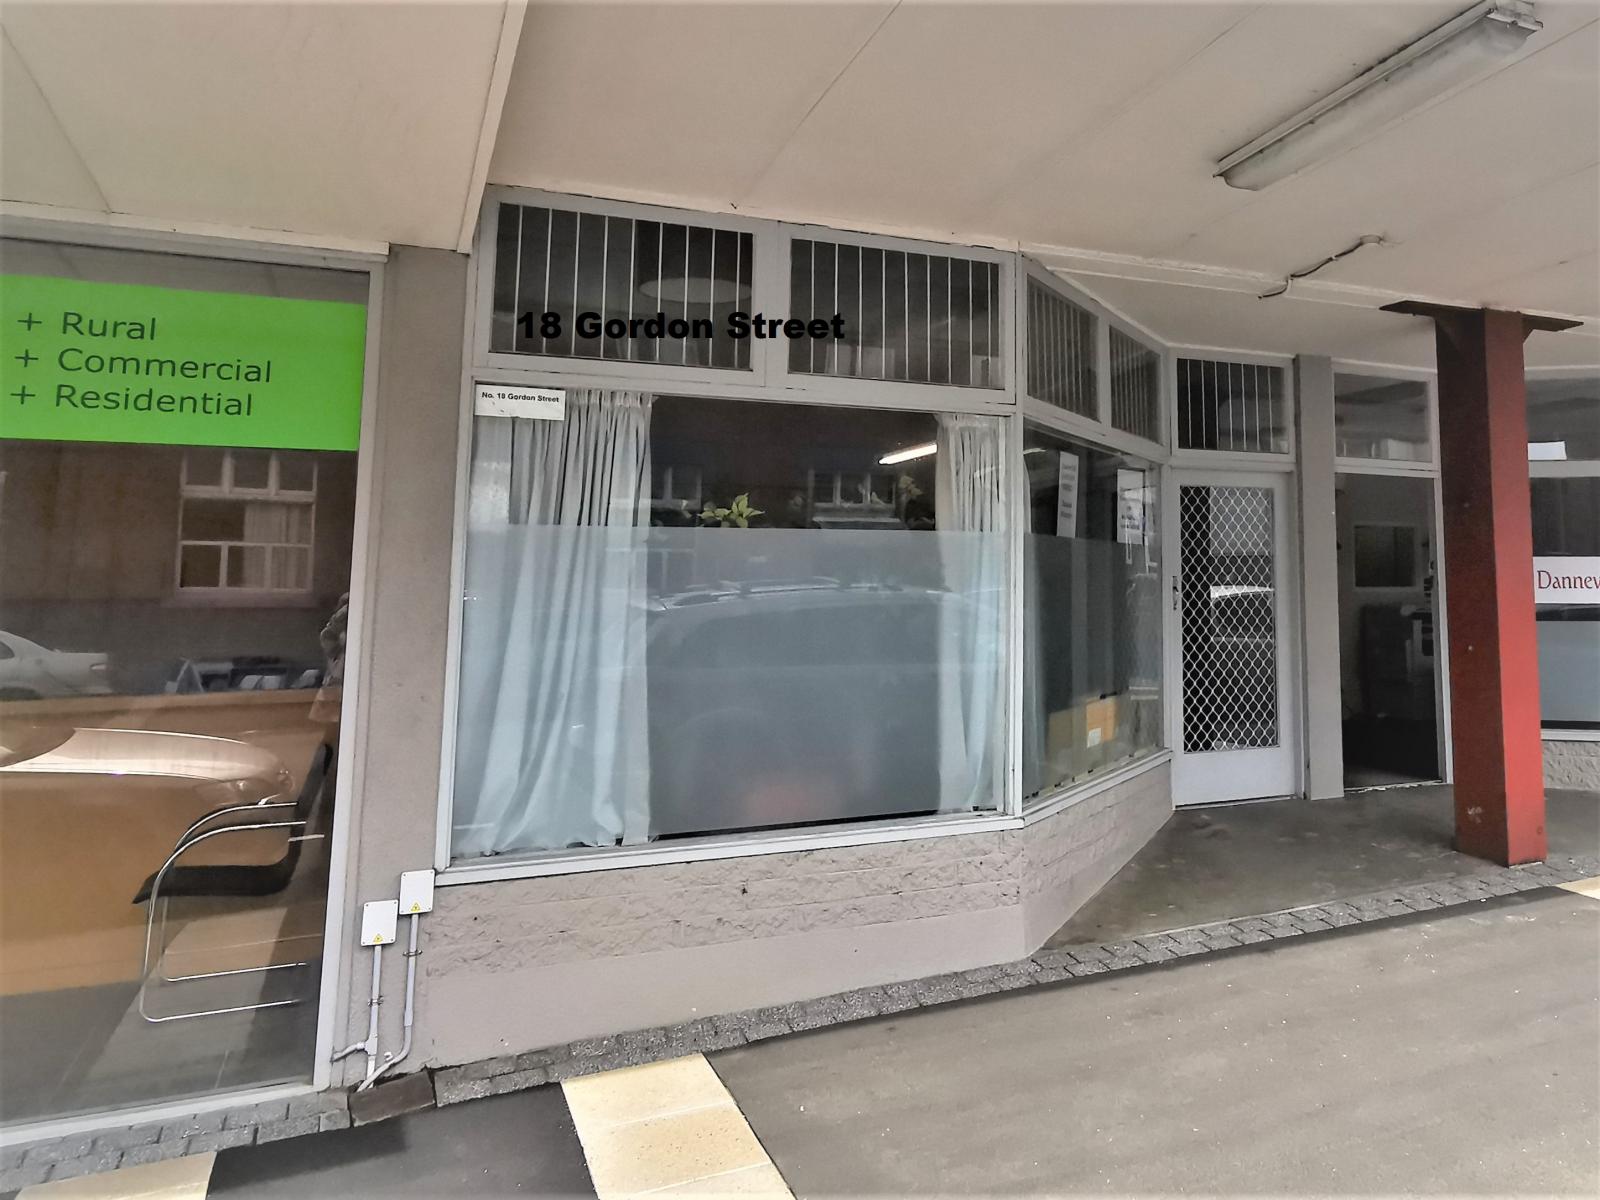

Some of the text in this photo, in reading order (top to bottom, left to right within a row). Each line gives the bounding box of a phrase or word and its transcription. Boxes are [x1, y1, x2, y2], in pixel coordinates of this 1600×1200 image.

[61, 311, 157, 341] Rural
[57, 347, 272, 383] Commercial
[55, 384, 252, 416] Residential
[481, 391, 494, 399] No.
[508, 393, 536, 401] Gordon
[537, 395, 560, 403] Street
